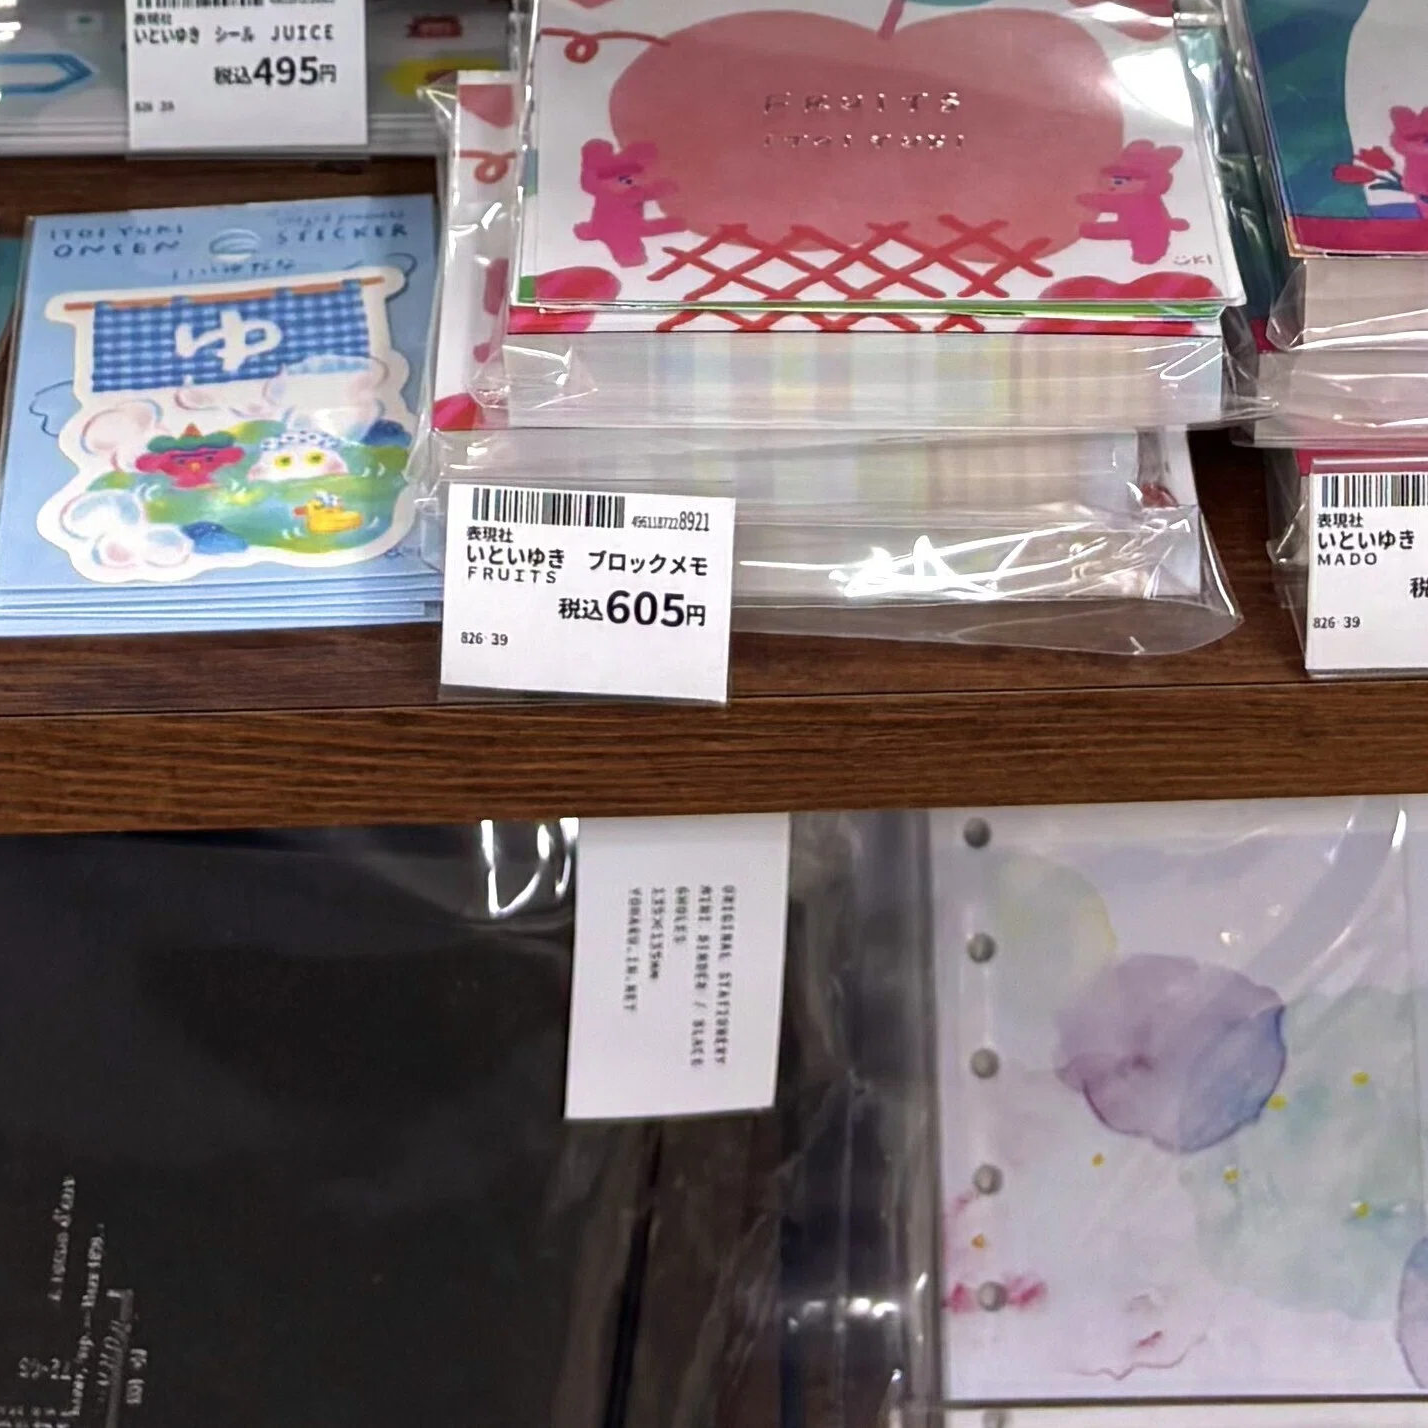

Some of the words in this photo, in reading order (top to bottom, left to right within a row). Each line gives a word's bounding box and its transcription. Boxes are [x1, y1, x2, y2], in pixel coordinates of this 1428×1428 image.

[134, 28, 200, 44] いといゆき
[215, 27, 256, 43] シール
[271, 25, 334, 42] JUICE
[214, 56, 336, 86] 税込495円
[764, 91, 961, 113] FRUITS
[277, 224, 408, 245] STICKER
[175, 309, 283, 372] ゆ
[1317, 513, 1363, 528] 表現社
[467, 526, 514, 544] 表現社
[1317, 530, 1415, 550] いといゆき
[467, 545, 565, 569] いといゆき
[588, 550, 708, 576] ブロックメモ
[1317, 553, 1378, 566] MADO
[468, 567, 557, 584] FRUITS
[558, 590, 706, 627] 税込605円
[1344, 617, 1361, 629] 39
[491, 633, 508, 646] 39
[718, 884, 735, 961] ORIGINAL
[695, 934, 710, 990] BINDER
